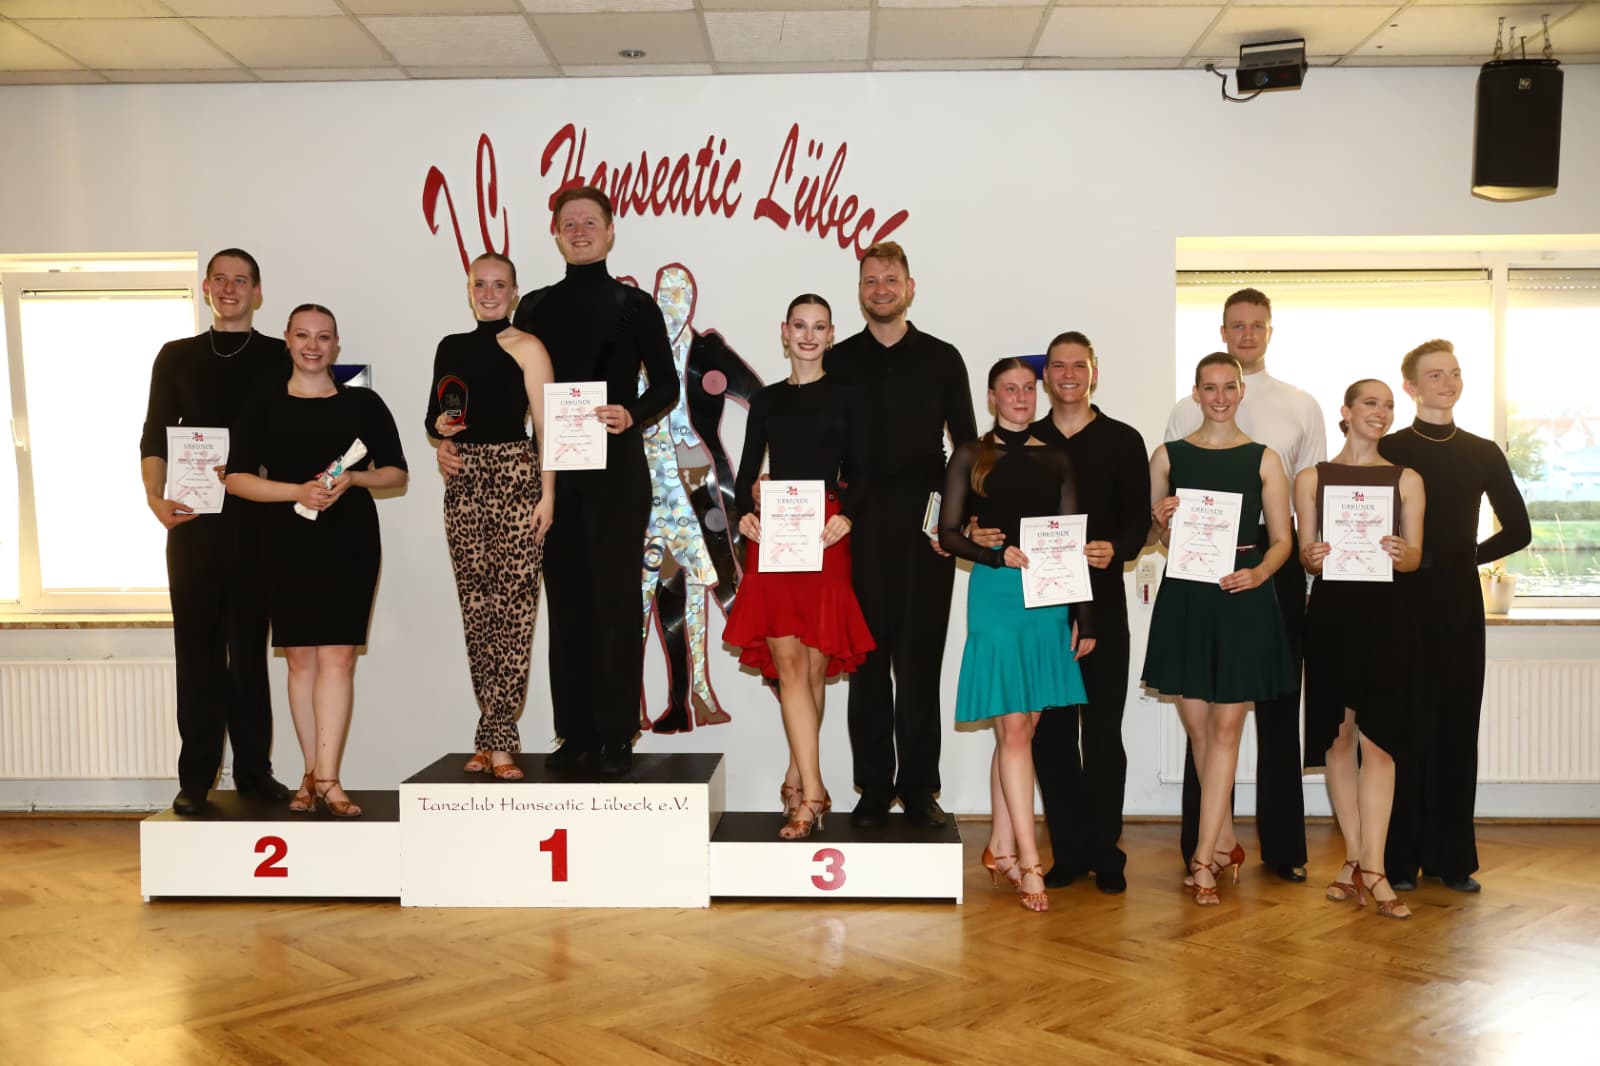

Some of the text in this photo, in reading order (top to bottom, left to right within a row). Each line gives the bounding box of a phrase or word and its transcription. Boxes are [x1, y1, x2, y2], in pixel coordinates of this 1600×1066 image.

[541, 123, 742, 235] Hanseatic
[417, 796, 689, 811] Tanzclub Hanseatic Lübeck e.V.
[254, 835, 288, 877] 2
[539, 828, 568, 882] 1
[811, 847, 846, 891] 3
